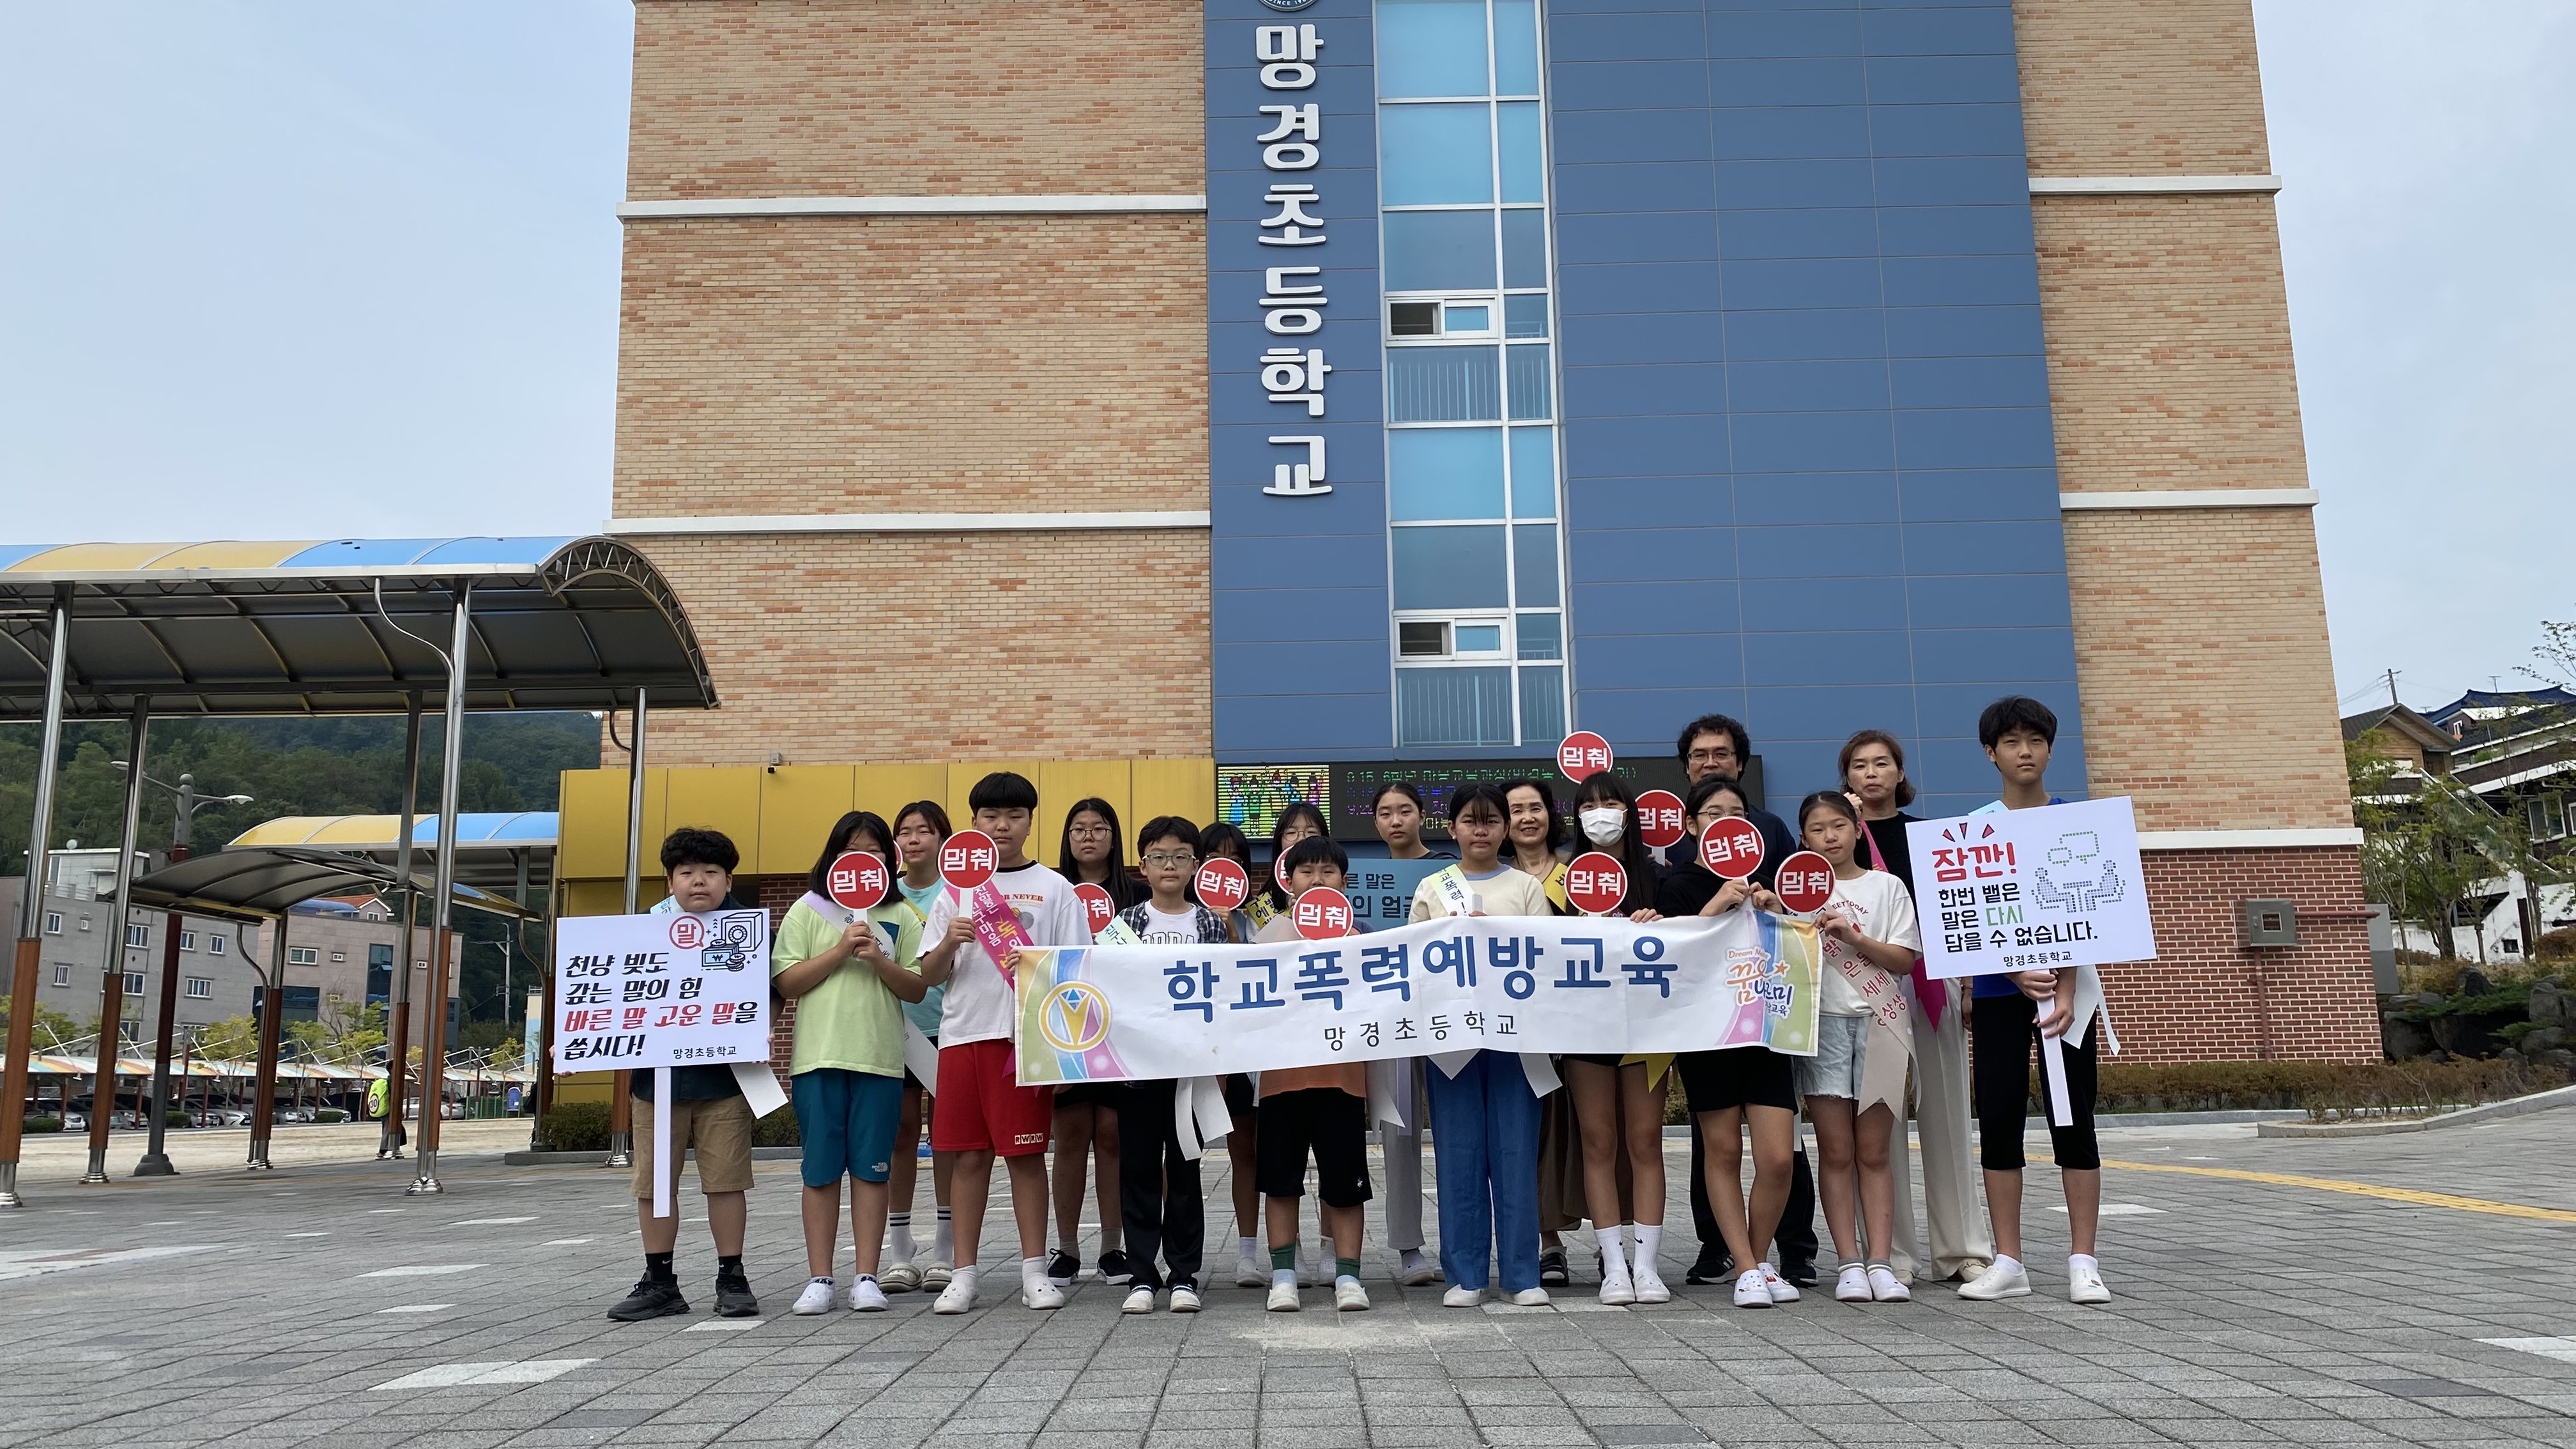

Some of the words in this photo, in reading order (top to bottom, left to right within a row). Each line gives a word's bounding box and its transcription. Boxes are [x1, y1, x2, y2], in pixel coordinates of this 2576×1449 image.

[1255, 24, 1332, 496] 망경초등학교
[1563, 746, 1608, 769] 멈춰
[1637, 808, 1683, 831] 멈춰
[943, 847, 994, 873] 멈춰
[1705, 831, 1759, 864] 멈춰
[1931, 841, 2017, 882] 잠깐!
[832, 867, 884, 893] 멈춰
[1199, 870, 1245, 899] 멈춰
[1366, 873, 1395, 889] 말은
[1439, 869, 1467, 914] 교폭력!
[1570, 870, 1621, 896] 멈춰
[1781, 870, 1830, 895] 멈춰
[1938, 886, 1975, 908] 한번
[1982, 882, 2020, 904] 뱉은
[1298, 903, 1348, 930] 멈춰
[1942, 909, 1979, 931] 말은
[1985, 905, 2024, 926] 다시
[677, 924, 696, 944] 말
[1944, 931, 1982, 953] 담을
[1989, 929, 2007, 948] 수
[2014, 921, 2099, 947] 없습니다.
[565, 954, 615, 978] 천냥
[621, 952, 670, 974] 빚도
[1729, 950, 1752, 958] Dream
[2004, 951, 2072, 967] 망경초등학교
[565, 982, 612, 1005] 갚는
[622, 979, 670, 1002] 말의
[678, 977, 703, 999] 힘
[1163, 935, 1678, 1023] 학교폭력예방교육
[564, 1009, 612, 1032] 바른
[622, 1007, 647, 1029] 말
[654, 1004, 702, 1027] 고운
[711, 1001, 758, 1025] 말을
[1324, 1010, 1518, 1051] 망경초등학교
[564, 1034, 647, 1061] 씁시다!
[673, 1046, 737, 1059] 망경초등학교
[1015, 1133, 1043, 1145] RWRW
